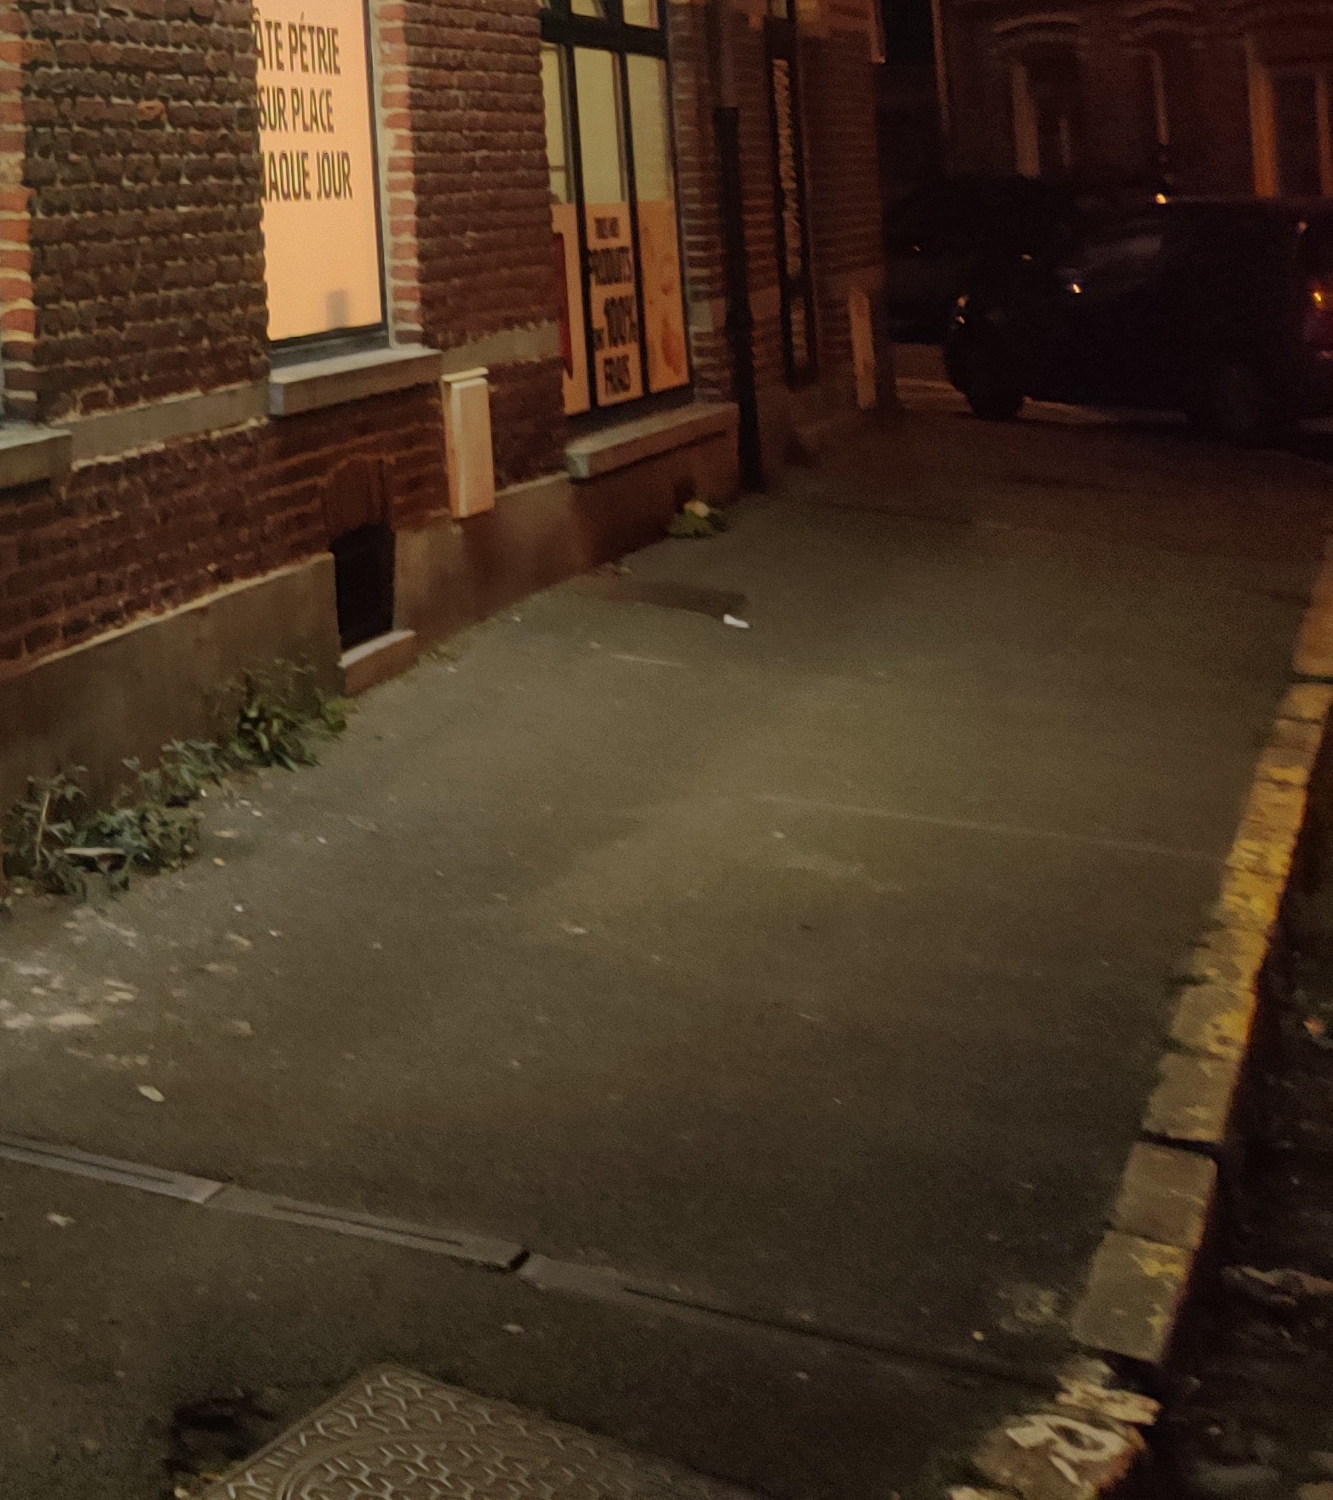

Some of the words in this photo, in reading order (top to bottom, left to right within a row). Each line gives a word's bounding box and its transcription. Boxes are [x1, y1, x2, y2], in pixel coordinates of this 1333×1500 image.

[253, 6, 284, 71] ÂTE
[288, 12, 340, 75] PÉTRIE
[257, 86, 287, 132] SUR
[290, 87, 334, 133] PLACE
[261, 151, 311, 202] AQUE
[316, 150, 353, 201] JOUR
